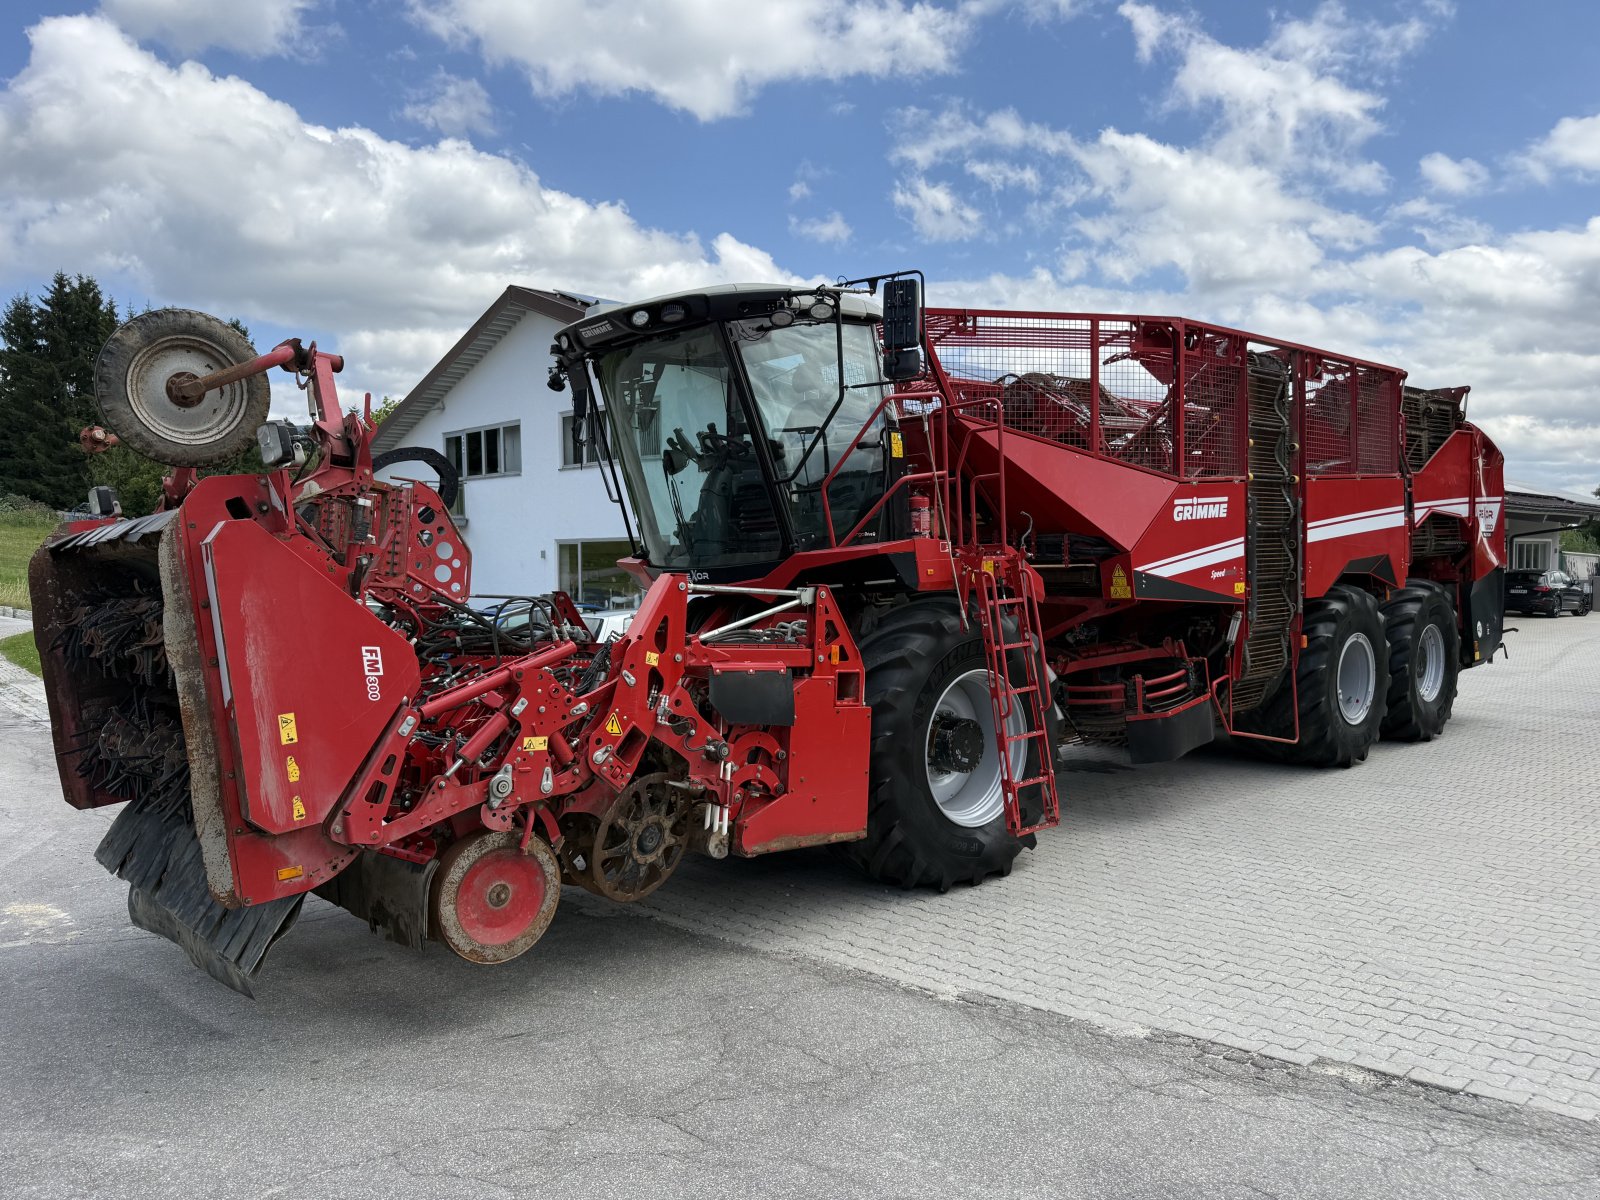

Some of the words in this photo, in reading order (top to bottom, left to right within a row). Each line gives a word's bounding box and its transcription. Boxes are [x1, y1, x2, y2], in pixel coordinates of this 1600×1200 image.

[581, 323, 613, 338] GRIMME
[1173, 497, 1228, 522] GRIMME
[687, 569, 710, 582] EXOR
[364, 648, 381, 674] FM
[366, 676, 381, 701] 300
